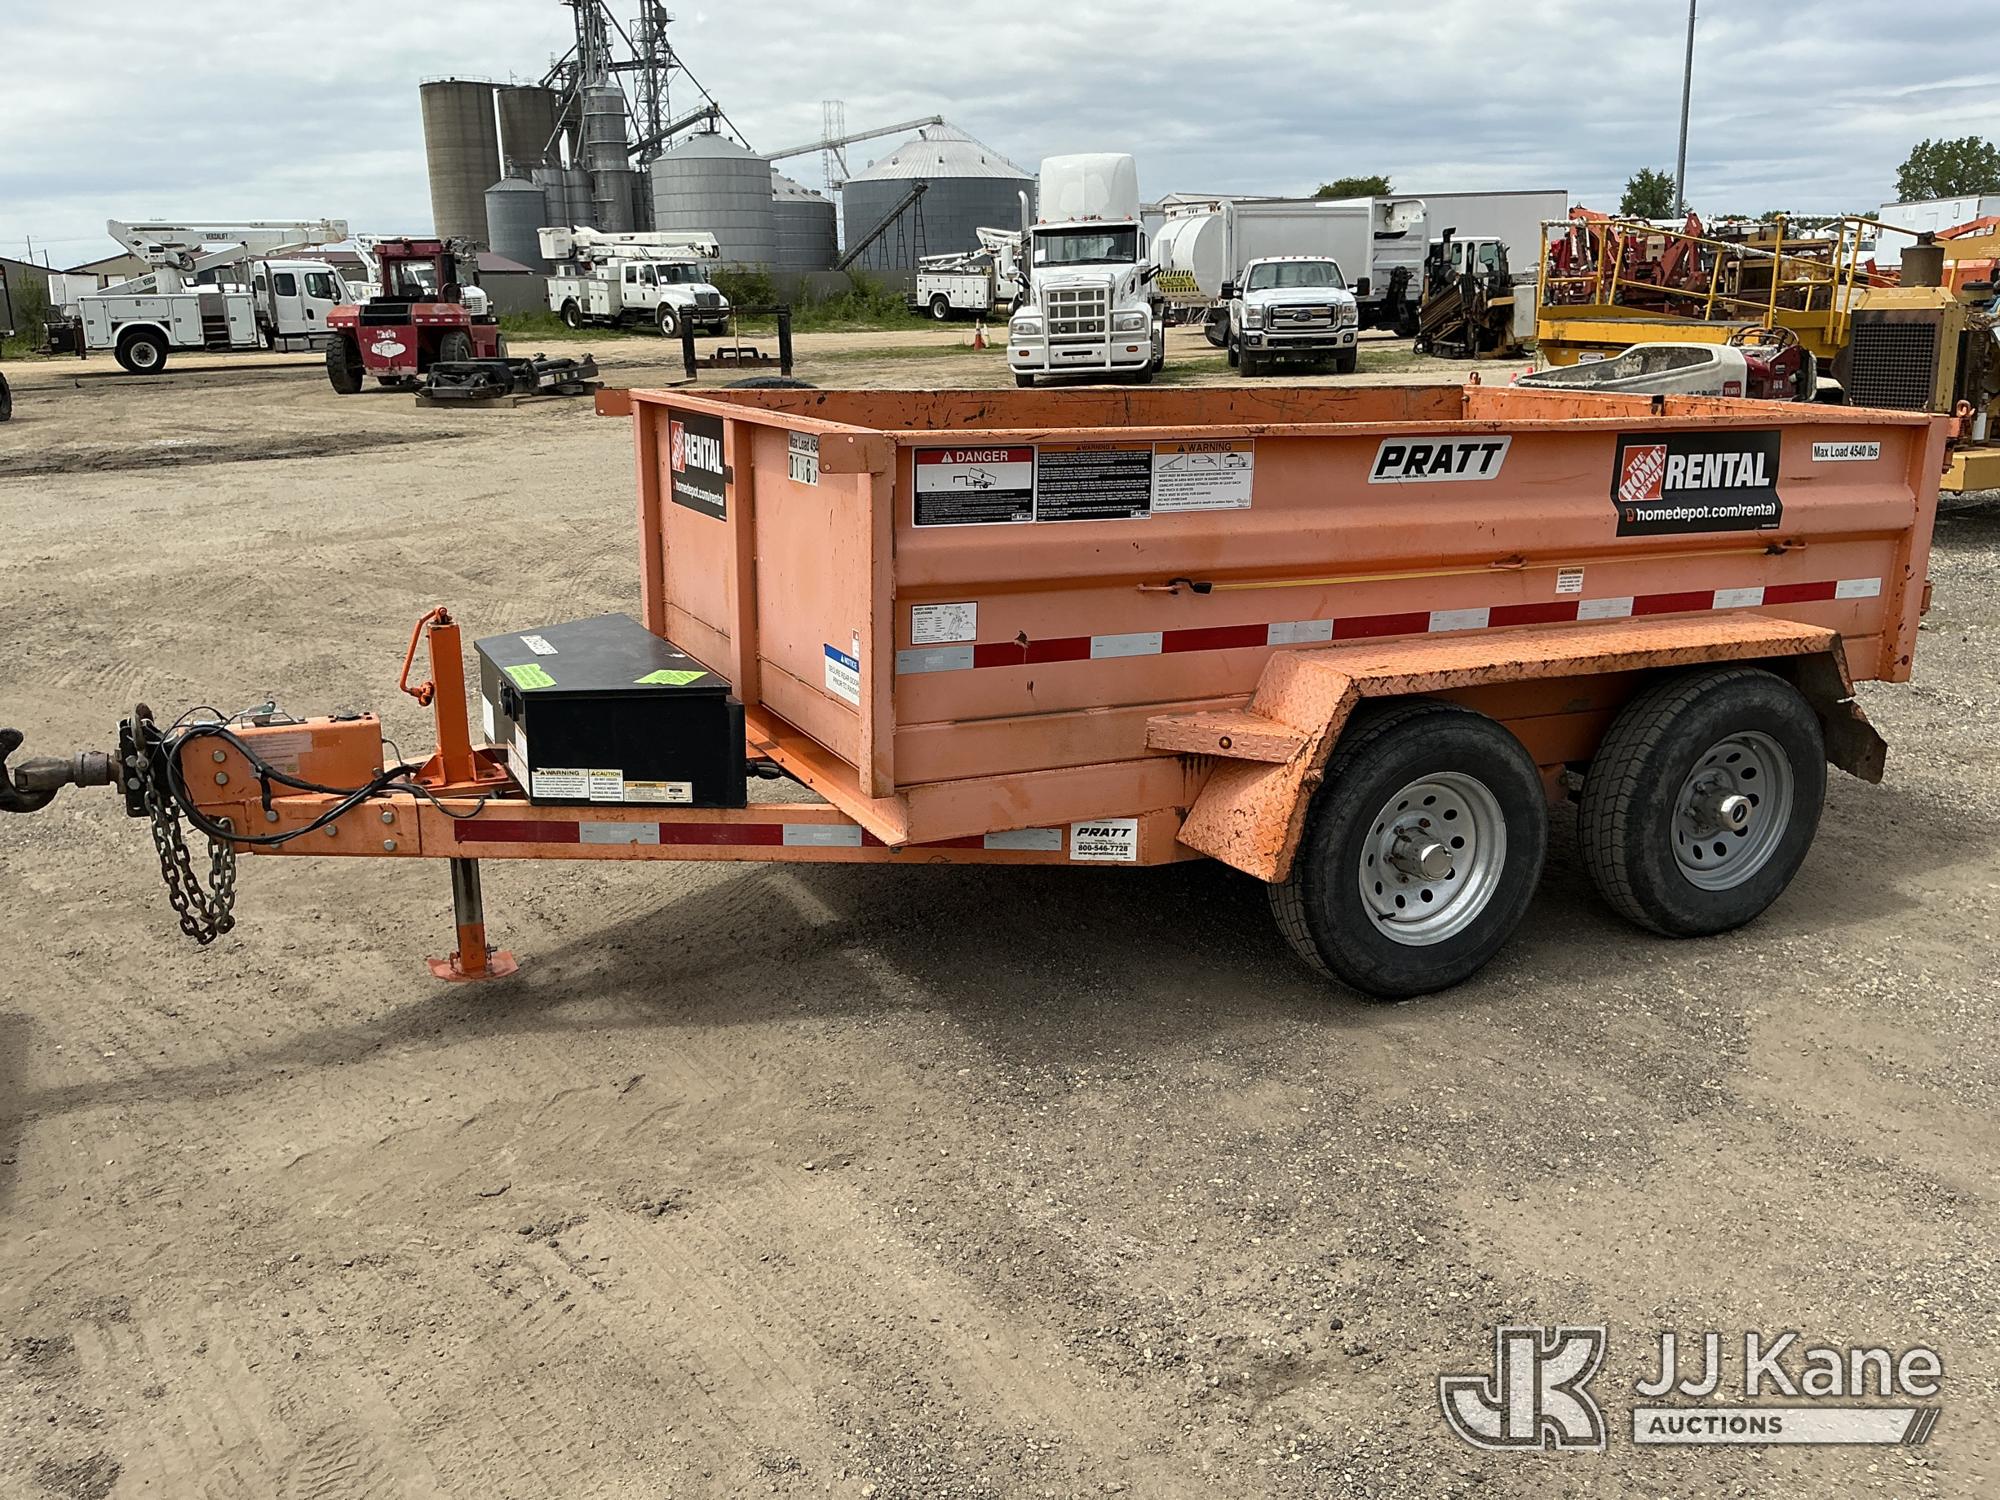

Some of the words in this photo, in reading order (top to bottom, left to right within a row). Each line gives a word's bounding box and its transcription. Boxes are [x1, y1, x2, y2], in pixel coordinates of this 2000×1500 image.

[684, 432, 724, 475] RENTAL
[956, 451, 1009, 462] DANGER
[1188, 443, 1232, 452] WARNING
[1814, 446, 1828, 457] Max
[1830, 445, 1848, 457] Load
[1850, 444, 1866, 457] 4540
[1868, 444, 1878, 457] lbs
[1374, 443, 1503, 476] PRATT
[1626, 451, 1646, 474] THE
[1664, 452, 1770, 490] RENTAL
[1620, 446, 1665, 500] HOME
[1635, 465, 1664, 499] DEPOT
[1636, 502, 1776, 522] homedepot.com/rental
[1077, 828, 1131, 837] PRATT
